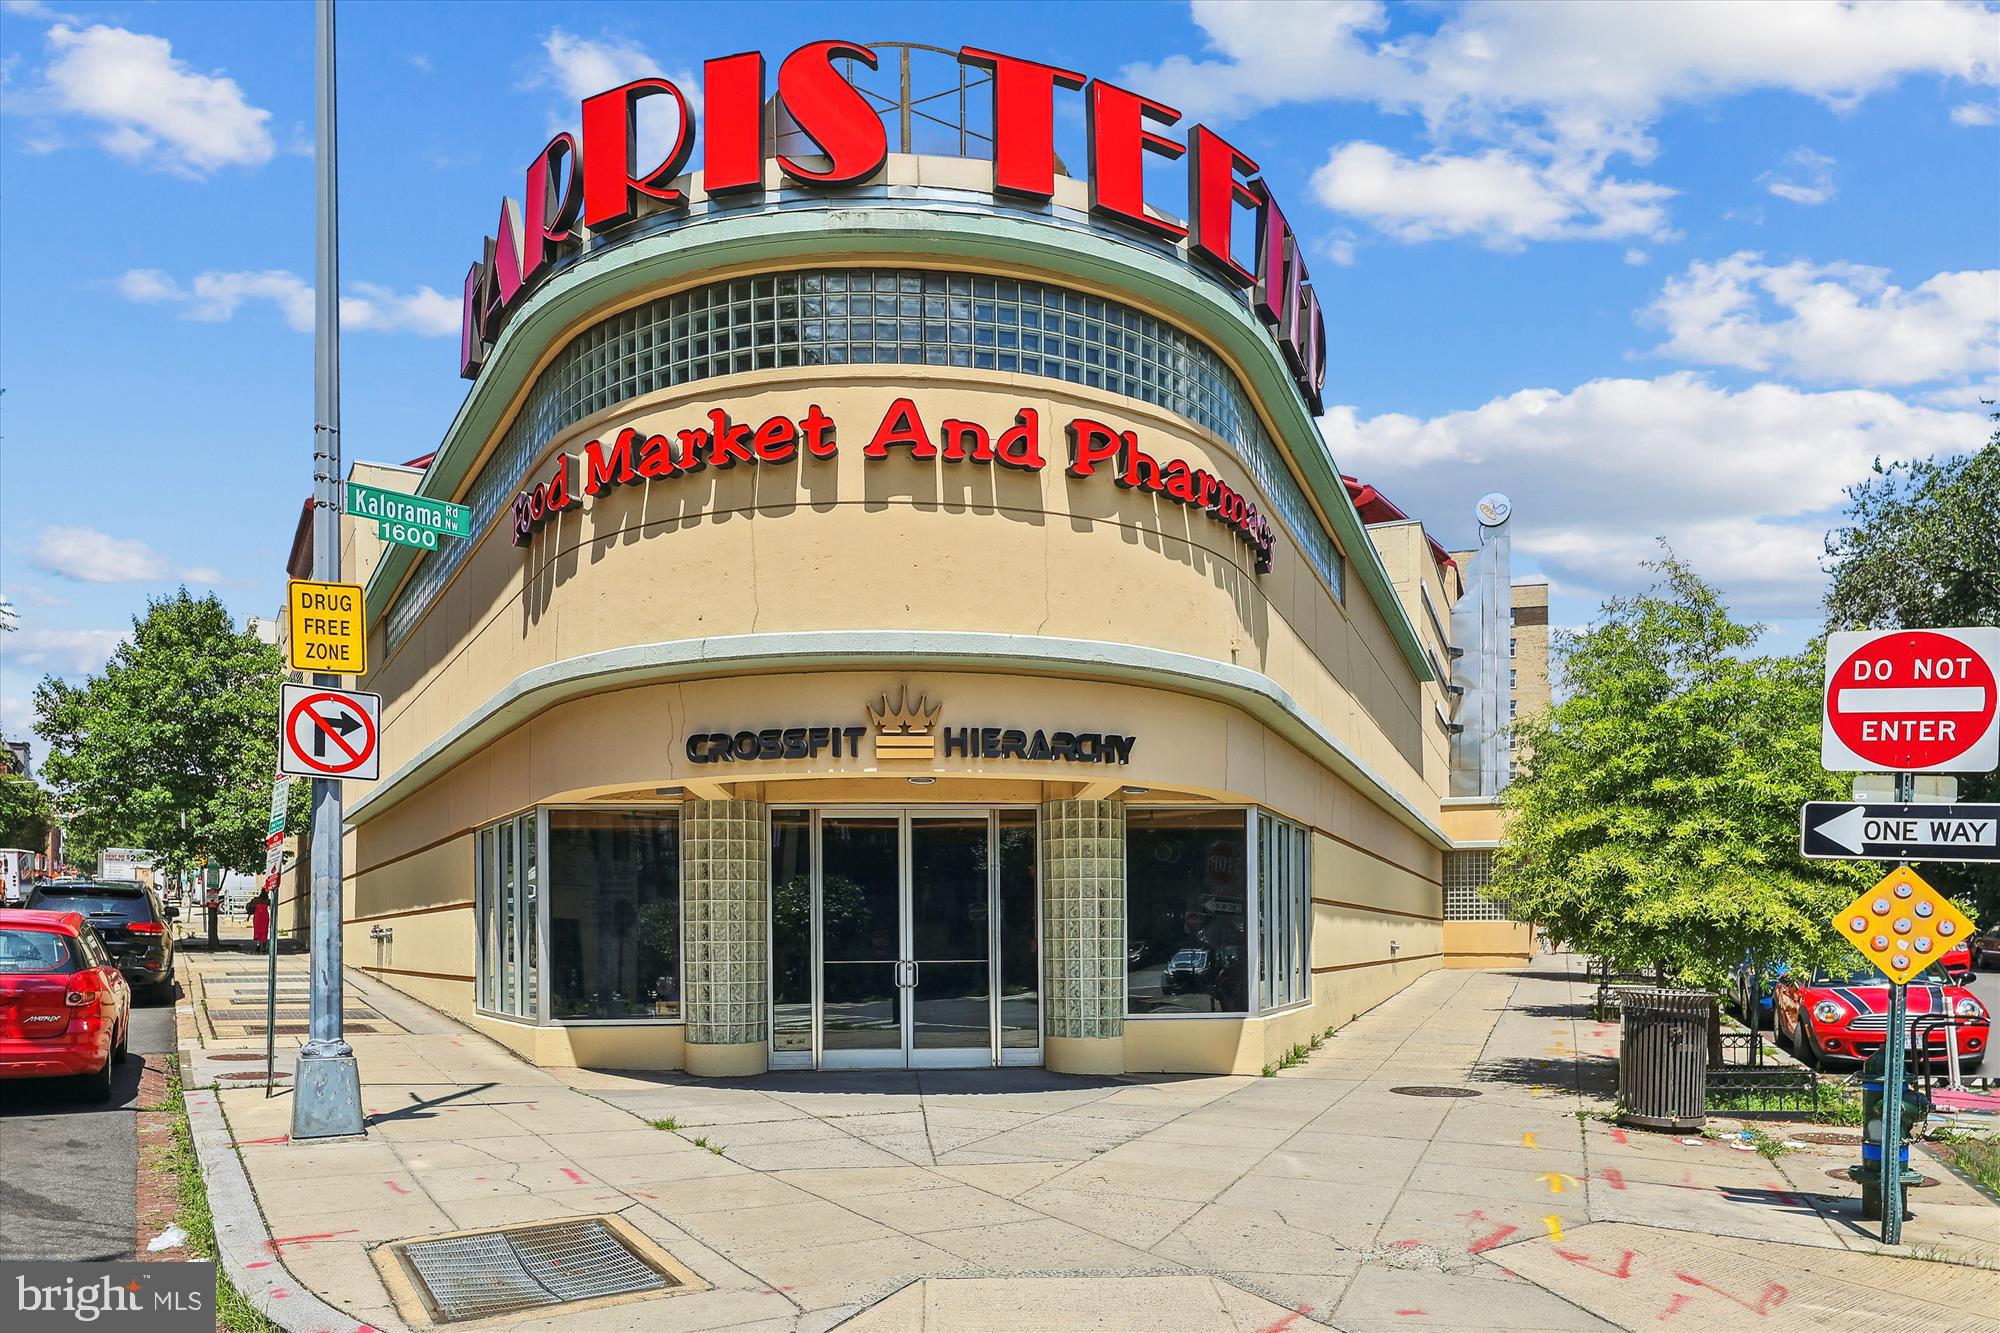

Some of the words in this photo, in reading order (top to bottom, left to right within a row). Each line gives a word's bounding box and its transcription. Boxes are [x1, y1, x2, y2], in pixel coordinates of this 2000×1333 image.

[461, 39, 887, 379] HARRIS
[512, 452, 577, 547] Food
[584, 404, 838, 498] Market
[863, 397, 1046, 472] And
[1066, 418, 1277, 574] Pharmacy
[355, 489, 441, 528] Kalorama
[445, 504, 459, 518] Rd
[381, 522, 436, 547] 1600
[301, 592, 352, 612] DRUG
[304, 618, 351, 636] FREE
[305, 643, 350, 661] ZONE
[1854, 659, 1893, 681] DO
[1913, 657, 1973, 680] NOT
[1862, 720, 1957, 742] ENTER
[686, 727, 867, 763] CROSSFIT
[943, 726, 1137, 765] HIERARCHY
[1863, 820, 1918, 842] ONE
[1930, 821, 1988, 843] WAY
[22, 1015, 61, 1024] MATRIX
